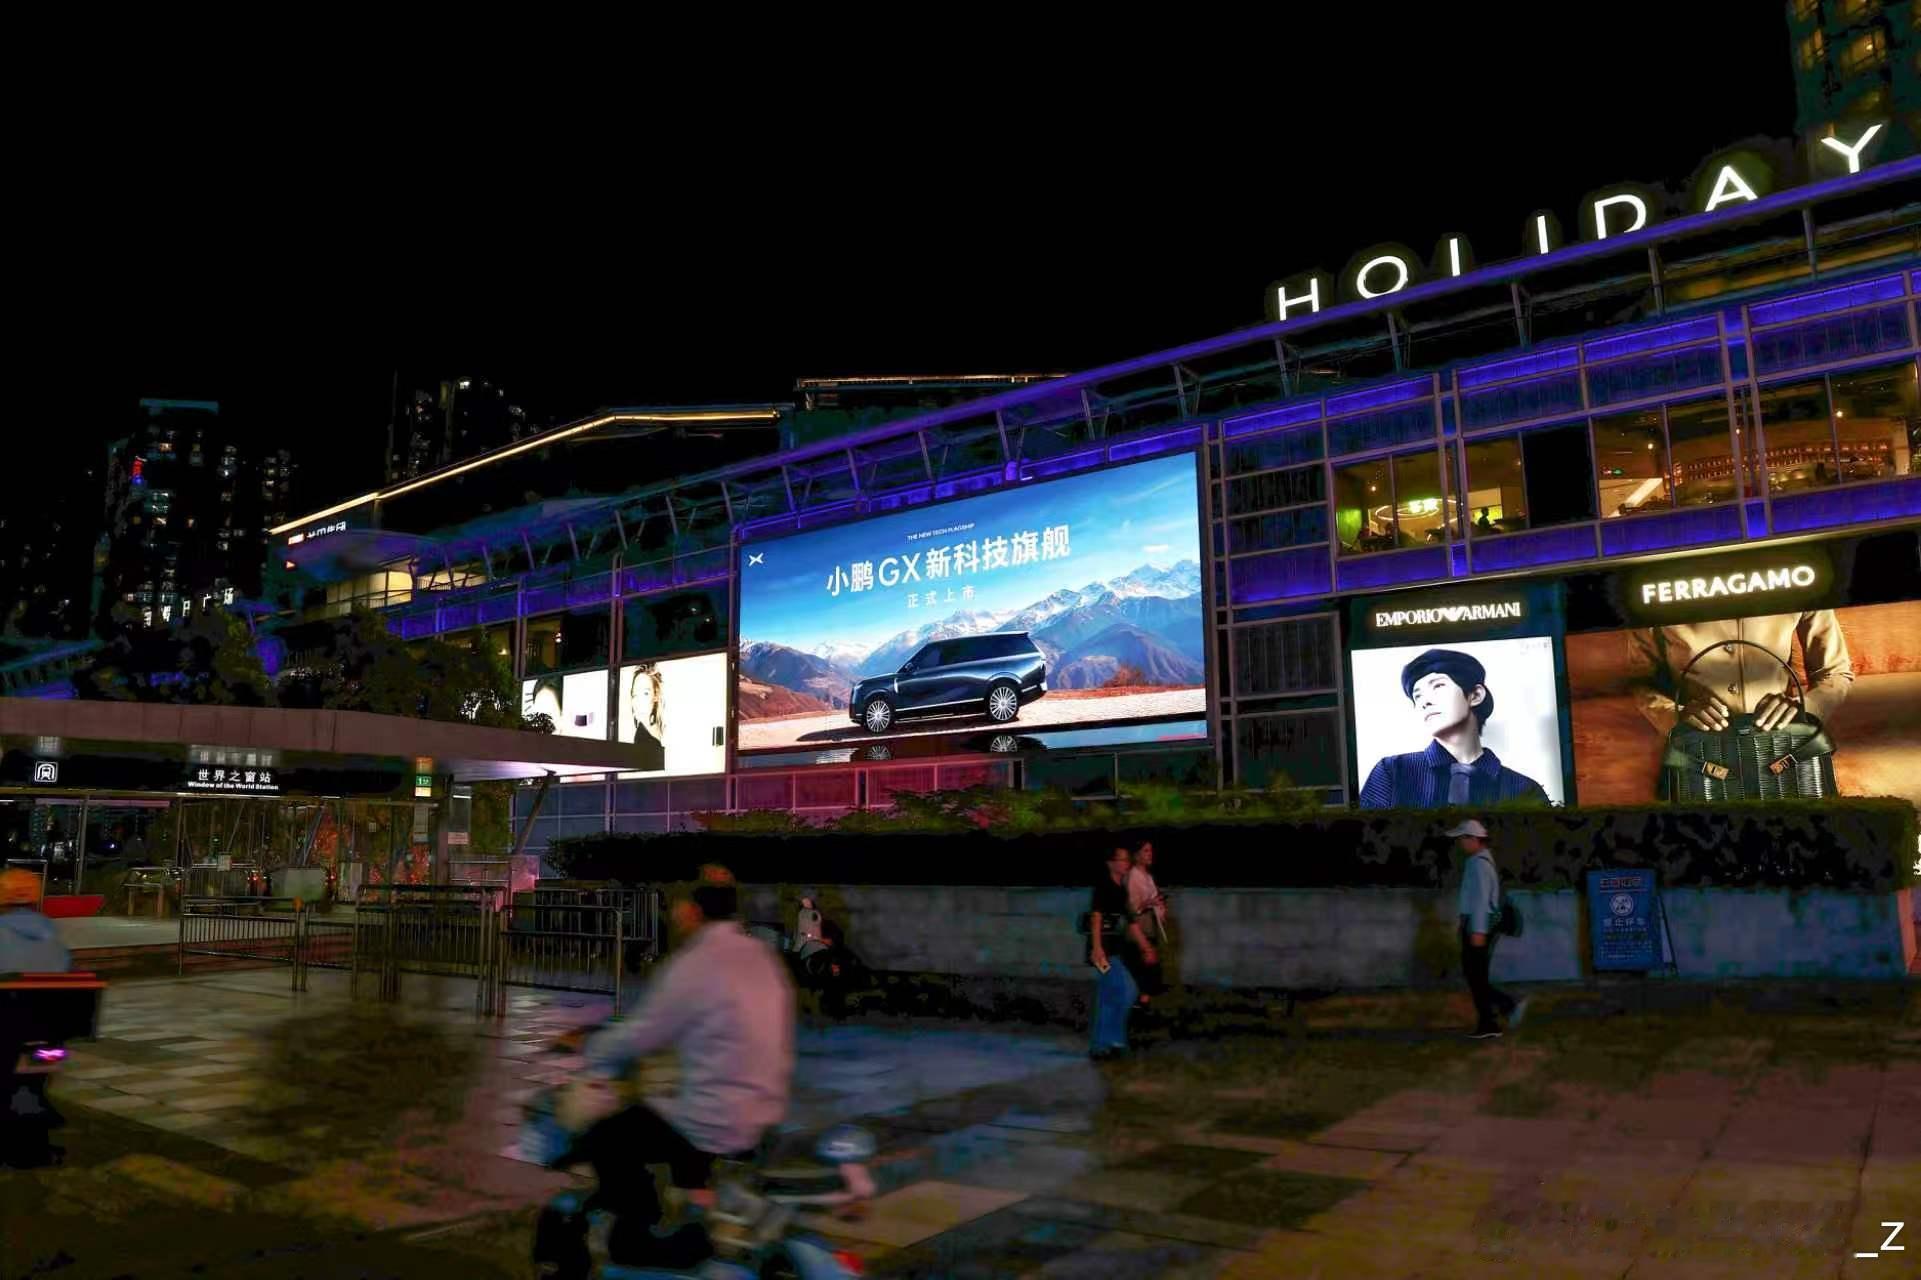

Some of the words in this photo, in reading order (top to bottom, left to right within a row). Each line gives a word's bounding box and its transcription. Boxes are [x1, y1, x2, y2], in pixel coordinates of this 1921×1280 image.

[918, 531, 931, 539] NEW
[907, 584, 976, 608] 正式上市
[1642, 565, 1815, 604] FERRAGAMO
[1375, 608, 1442, 627] EMPORIO
[1461, 602, 1521, 621] ARMANI
[198, 768, 272, 783] 世界之窗站
